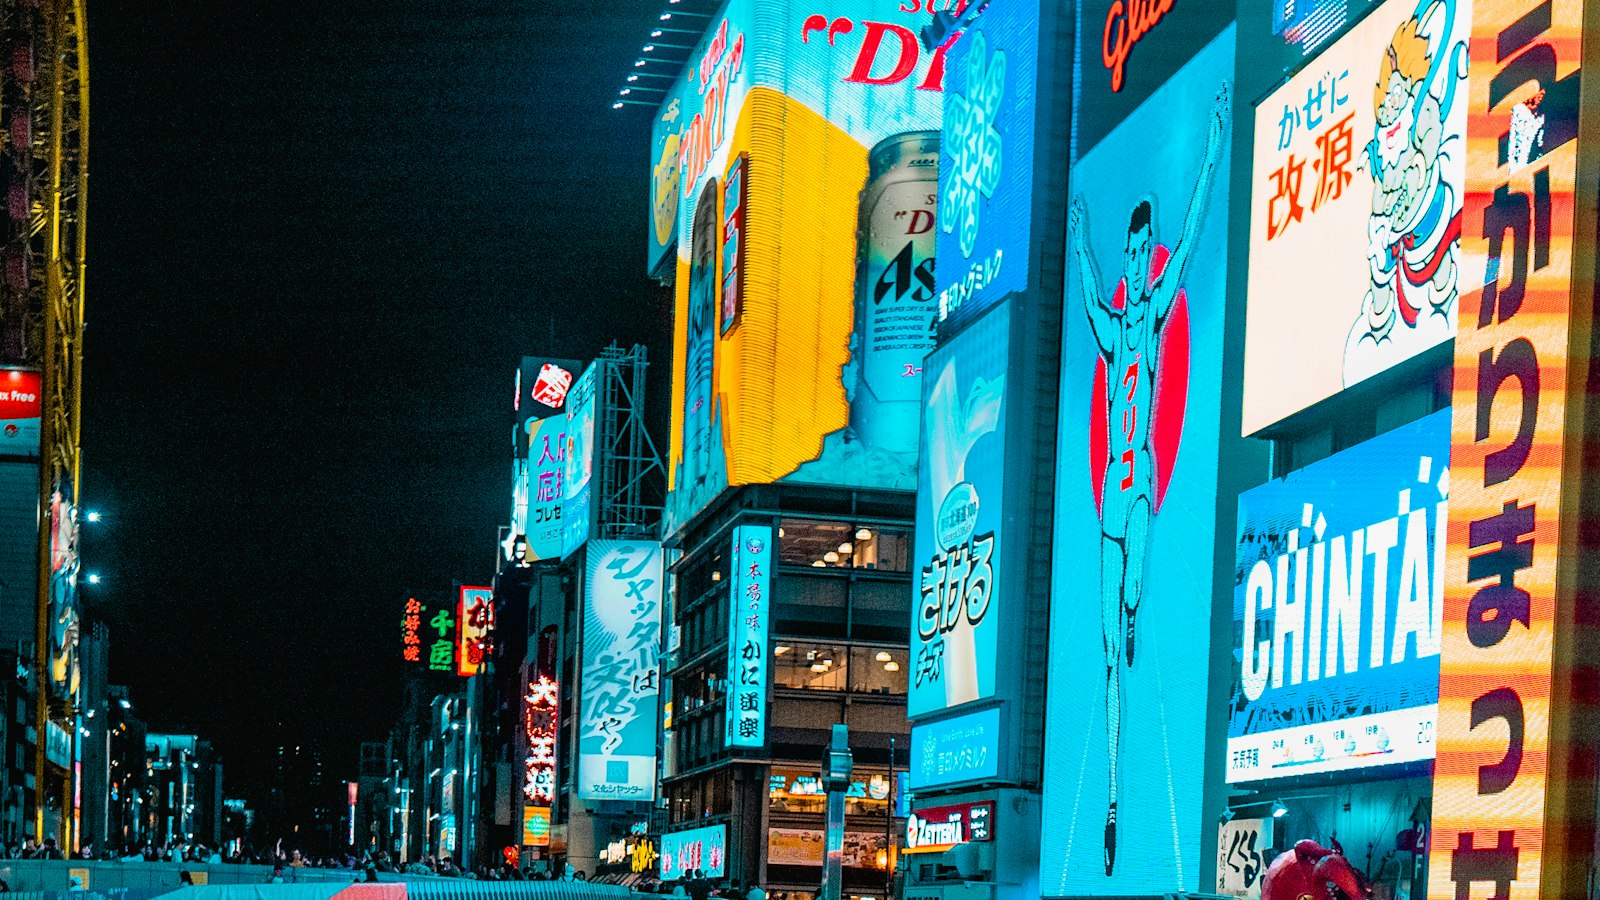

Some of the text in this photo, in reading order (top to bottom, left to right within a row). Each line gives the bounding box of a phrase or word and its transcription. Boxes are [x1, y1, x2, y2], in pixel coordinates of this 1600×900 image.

[1278, 70, 1349, 151] かぜに
[1267, 111, 1355, 242] 改源
[938, 249, 1003, 323] 雪印メグミルク
[11, 390, 36, 402] Free
[1121, 352, 1142, 492] グリコ
[745, 561, 763, 632] 本場の味
[918, 530, 995, 644] さける
[403, 597, 421, 661] お好み焼
[430, 609, 456, 665] 千房
[915, 640, 944, 688] チーズ
[591, 784, 643, 795] 文化シャッター
[938, 744, 987, 775] 雪印メグミルク
